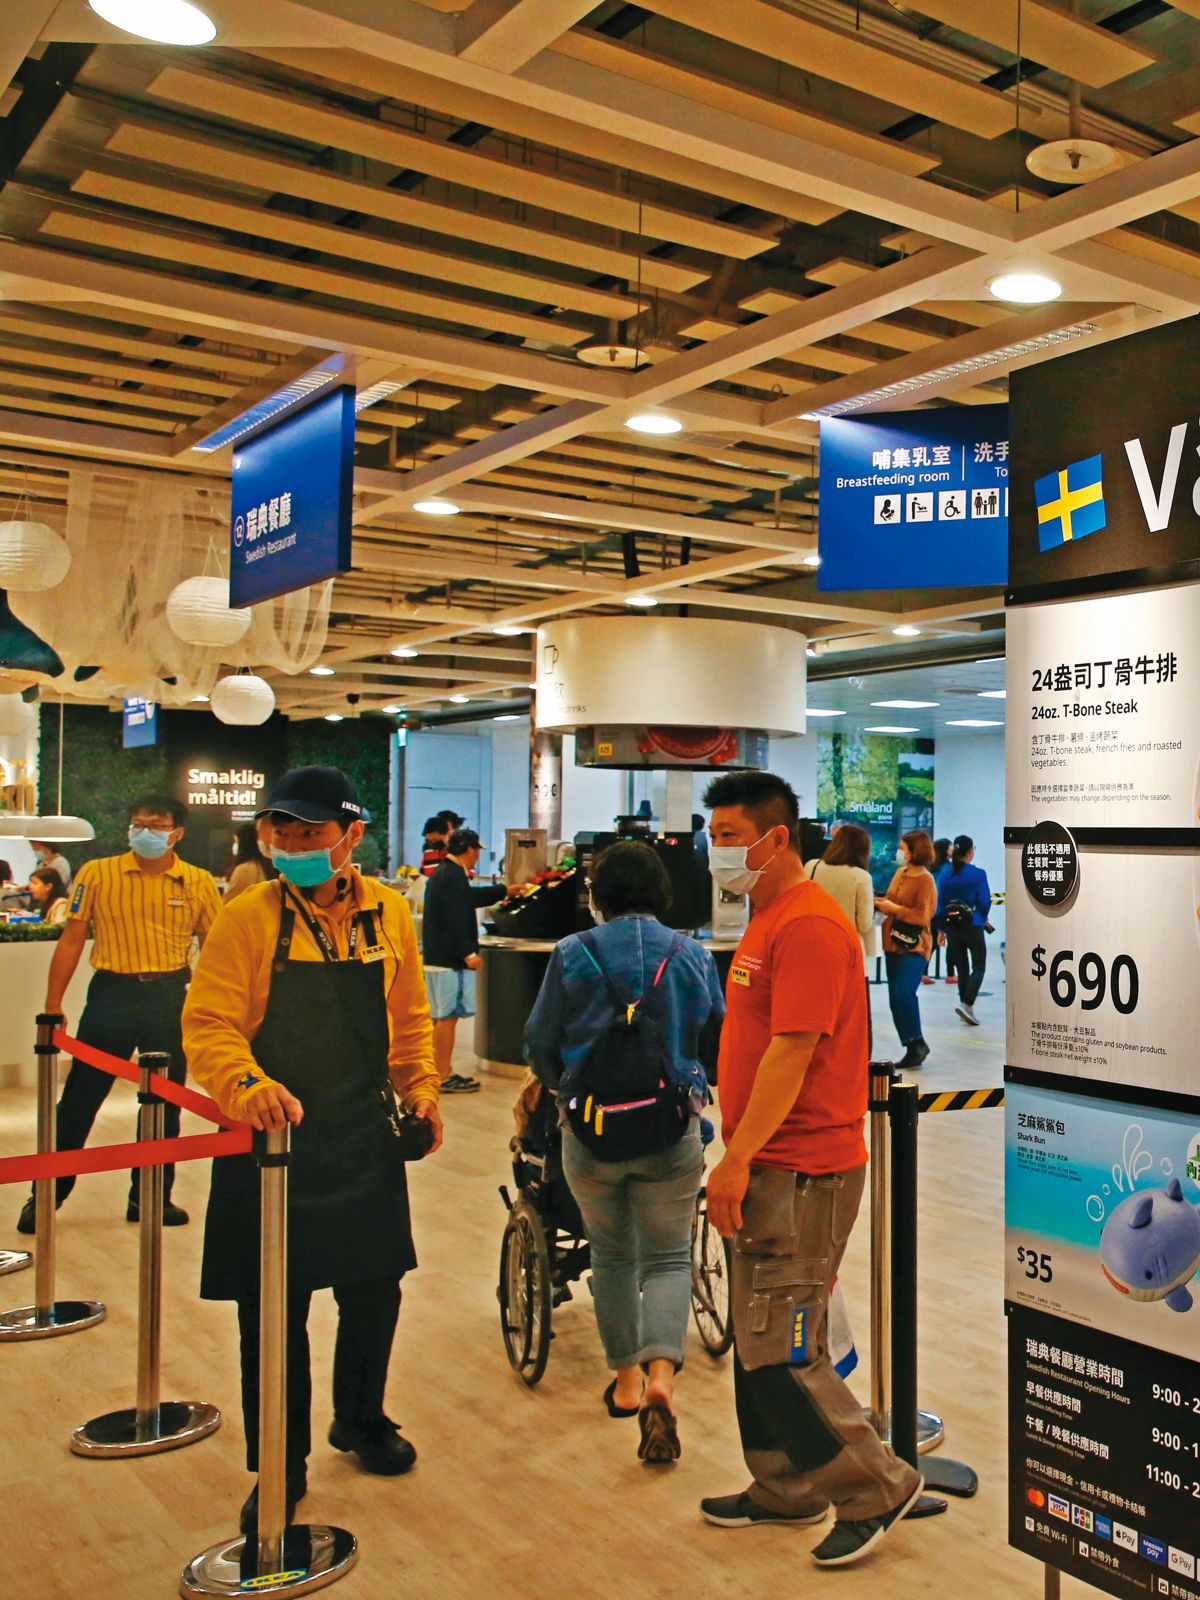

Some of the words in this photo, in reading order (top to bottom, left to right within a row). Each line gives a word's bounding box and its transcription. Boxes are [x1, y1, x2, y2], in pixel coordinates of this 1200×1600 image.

[872, 445, 951, 470] 哺集乳室
[836, 473, 915, 488] Breastfeeding
[919, 472, 950, 482] room
[246, 492, 291, 542] 瑞典餐廳
[267, 531, 296, 554] Restaurant
[1031, 652, 1178, 691] 24盎司丁骨牛排
[1032, 706, 1060, 719] 24oz.
[1063, 703, 1101, 717] T-Bone
[1105, 699, 1138, 715] Steak
[1051, 746, 1072, 755] T-bone
[1096, 743, 1119, 752] french
[1120, 743, 1135, 751] fries
[1138, 742, 1151, 750] and
[1153, 740, 1182, 750] roasted
[1031, 759, 1068, 769] vegetables.
[188, 769, 265, 789] Smaklig
[188, 788, 256, 805] måltid!
[850, 800, 892, 813] Småland
[1031, 944, 1139, 1014] $690
[1042, 1033, 1061, 1041] product
[1063, 1035, 1084, 1043] contains
[1086, 1037, 1103, 1046] gluten
[1104, 1040, 1114, 1048] and
[1116, 1042, 1138, 1051] soybean
[1140, 1045, 1167, 1055] products.
[1018, 1113, 1065, 1135] 芝麻鯊鯊包
[1018, 1132, 1033, 1140] Shark
[1034, 1136, 1045, 1144] Bun
[1017, 1246, 1052, 1283] $35
[1026, 1338, 1123, 1388] 瑞典餐廳營業時間
[1026, 1361, 1049, 1374] Swedish
[1051, 1369, 1084, 1388] Restaurant
[1084, 1382, 1110, 1399] Opening
[1111, 1391, 1130, 1404] Hours
[1026, 1381, 1081, 1413] 早餐供應時間
[1152, 1384, 1180, 1406] 9:00
[1026, 1414, 1043, 1433] 午餐
[1052, 1425, 1109, 1459] 晚餐供應時間
[1152, 1428, 1180, 1450] 9:00
[1146, 1464, 1180, 1489] 11:00
[1053, 1502, 1064, 1513] VISA
[1051, 1529, 1067, 1544] Wi-Fi
[1122, 1531, 1135, 1546] Pay
[1147, 1548, 1159, 1559] pay
[1180, 1557, 1191, 1571] Pay
[247, 1571, 300, 1585] IKEA
